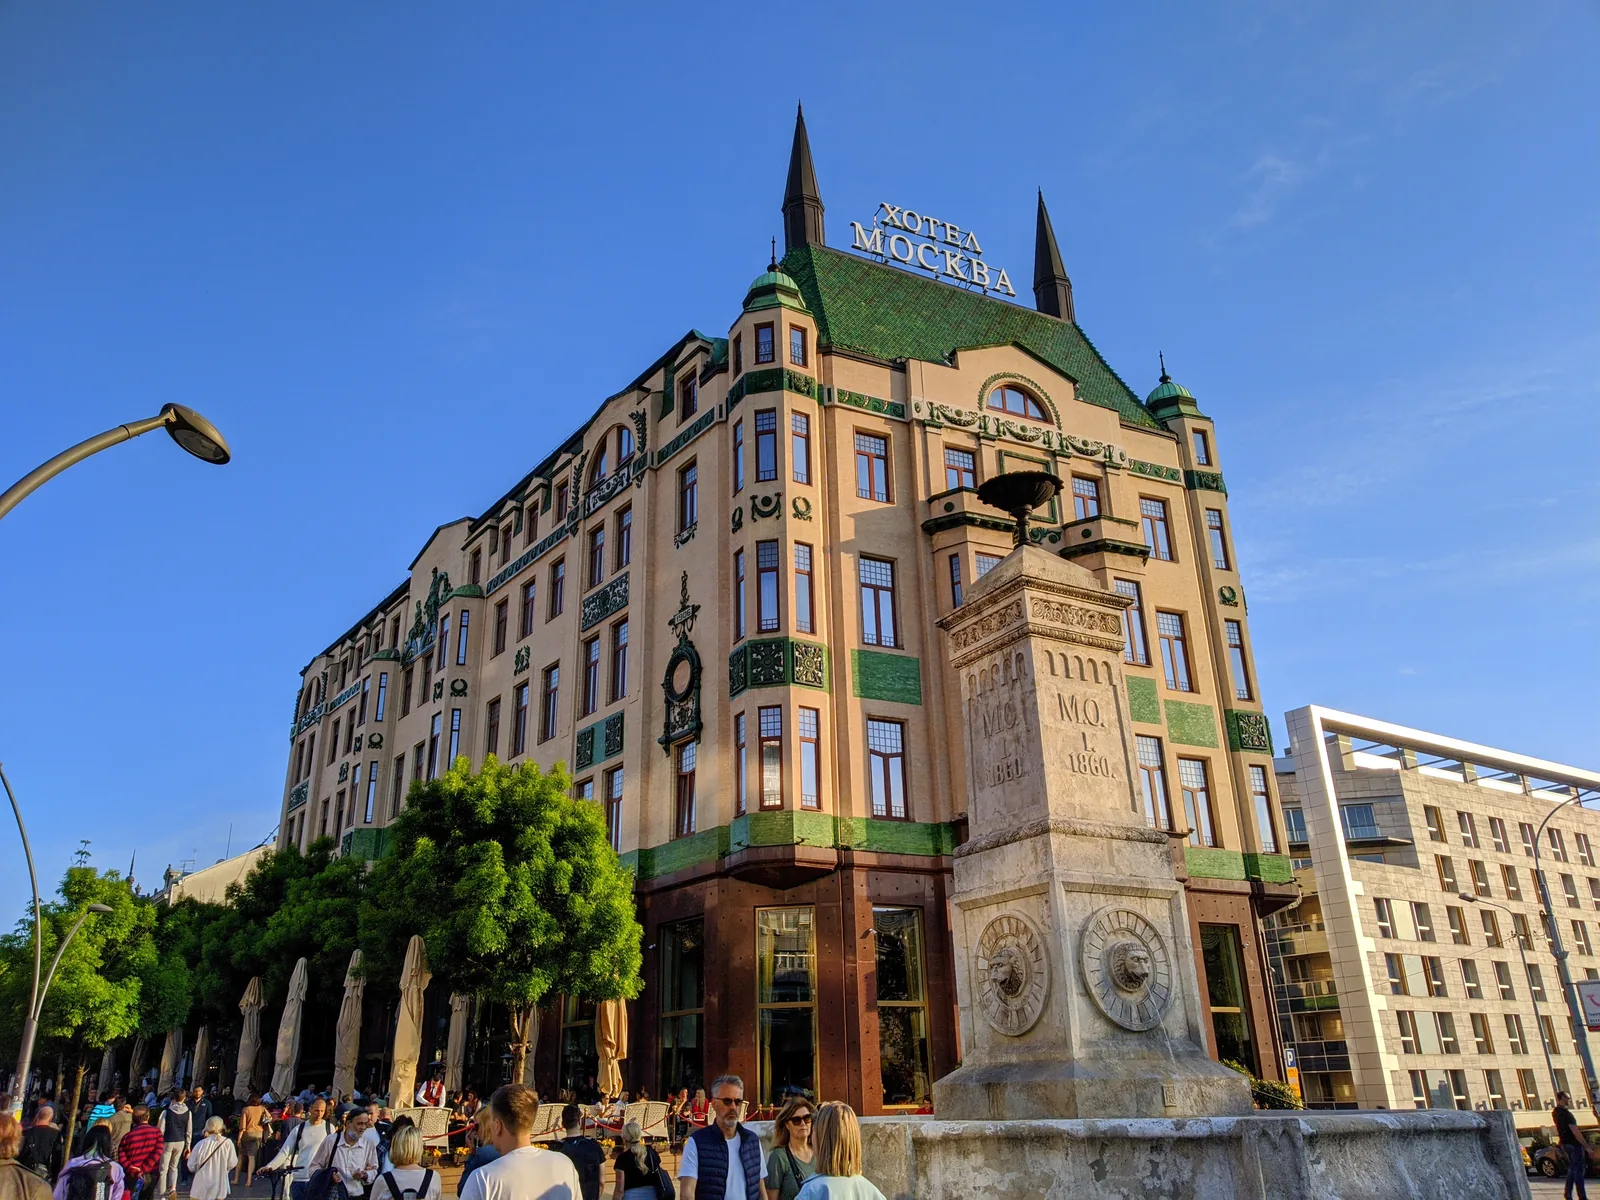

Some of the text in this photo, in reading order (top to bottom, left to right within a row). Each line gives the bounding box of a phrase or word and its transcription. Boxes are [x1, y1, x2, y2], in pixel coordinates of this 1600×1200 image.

[881, 202, 982, 254] ХОТЕЛ
[850, 221, 1016, 297] МОСКВА
[676, 608, 691, 621] 1906
[1287, 1051, 1293, 1066] P
